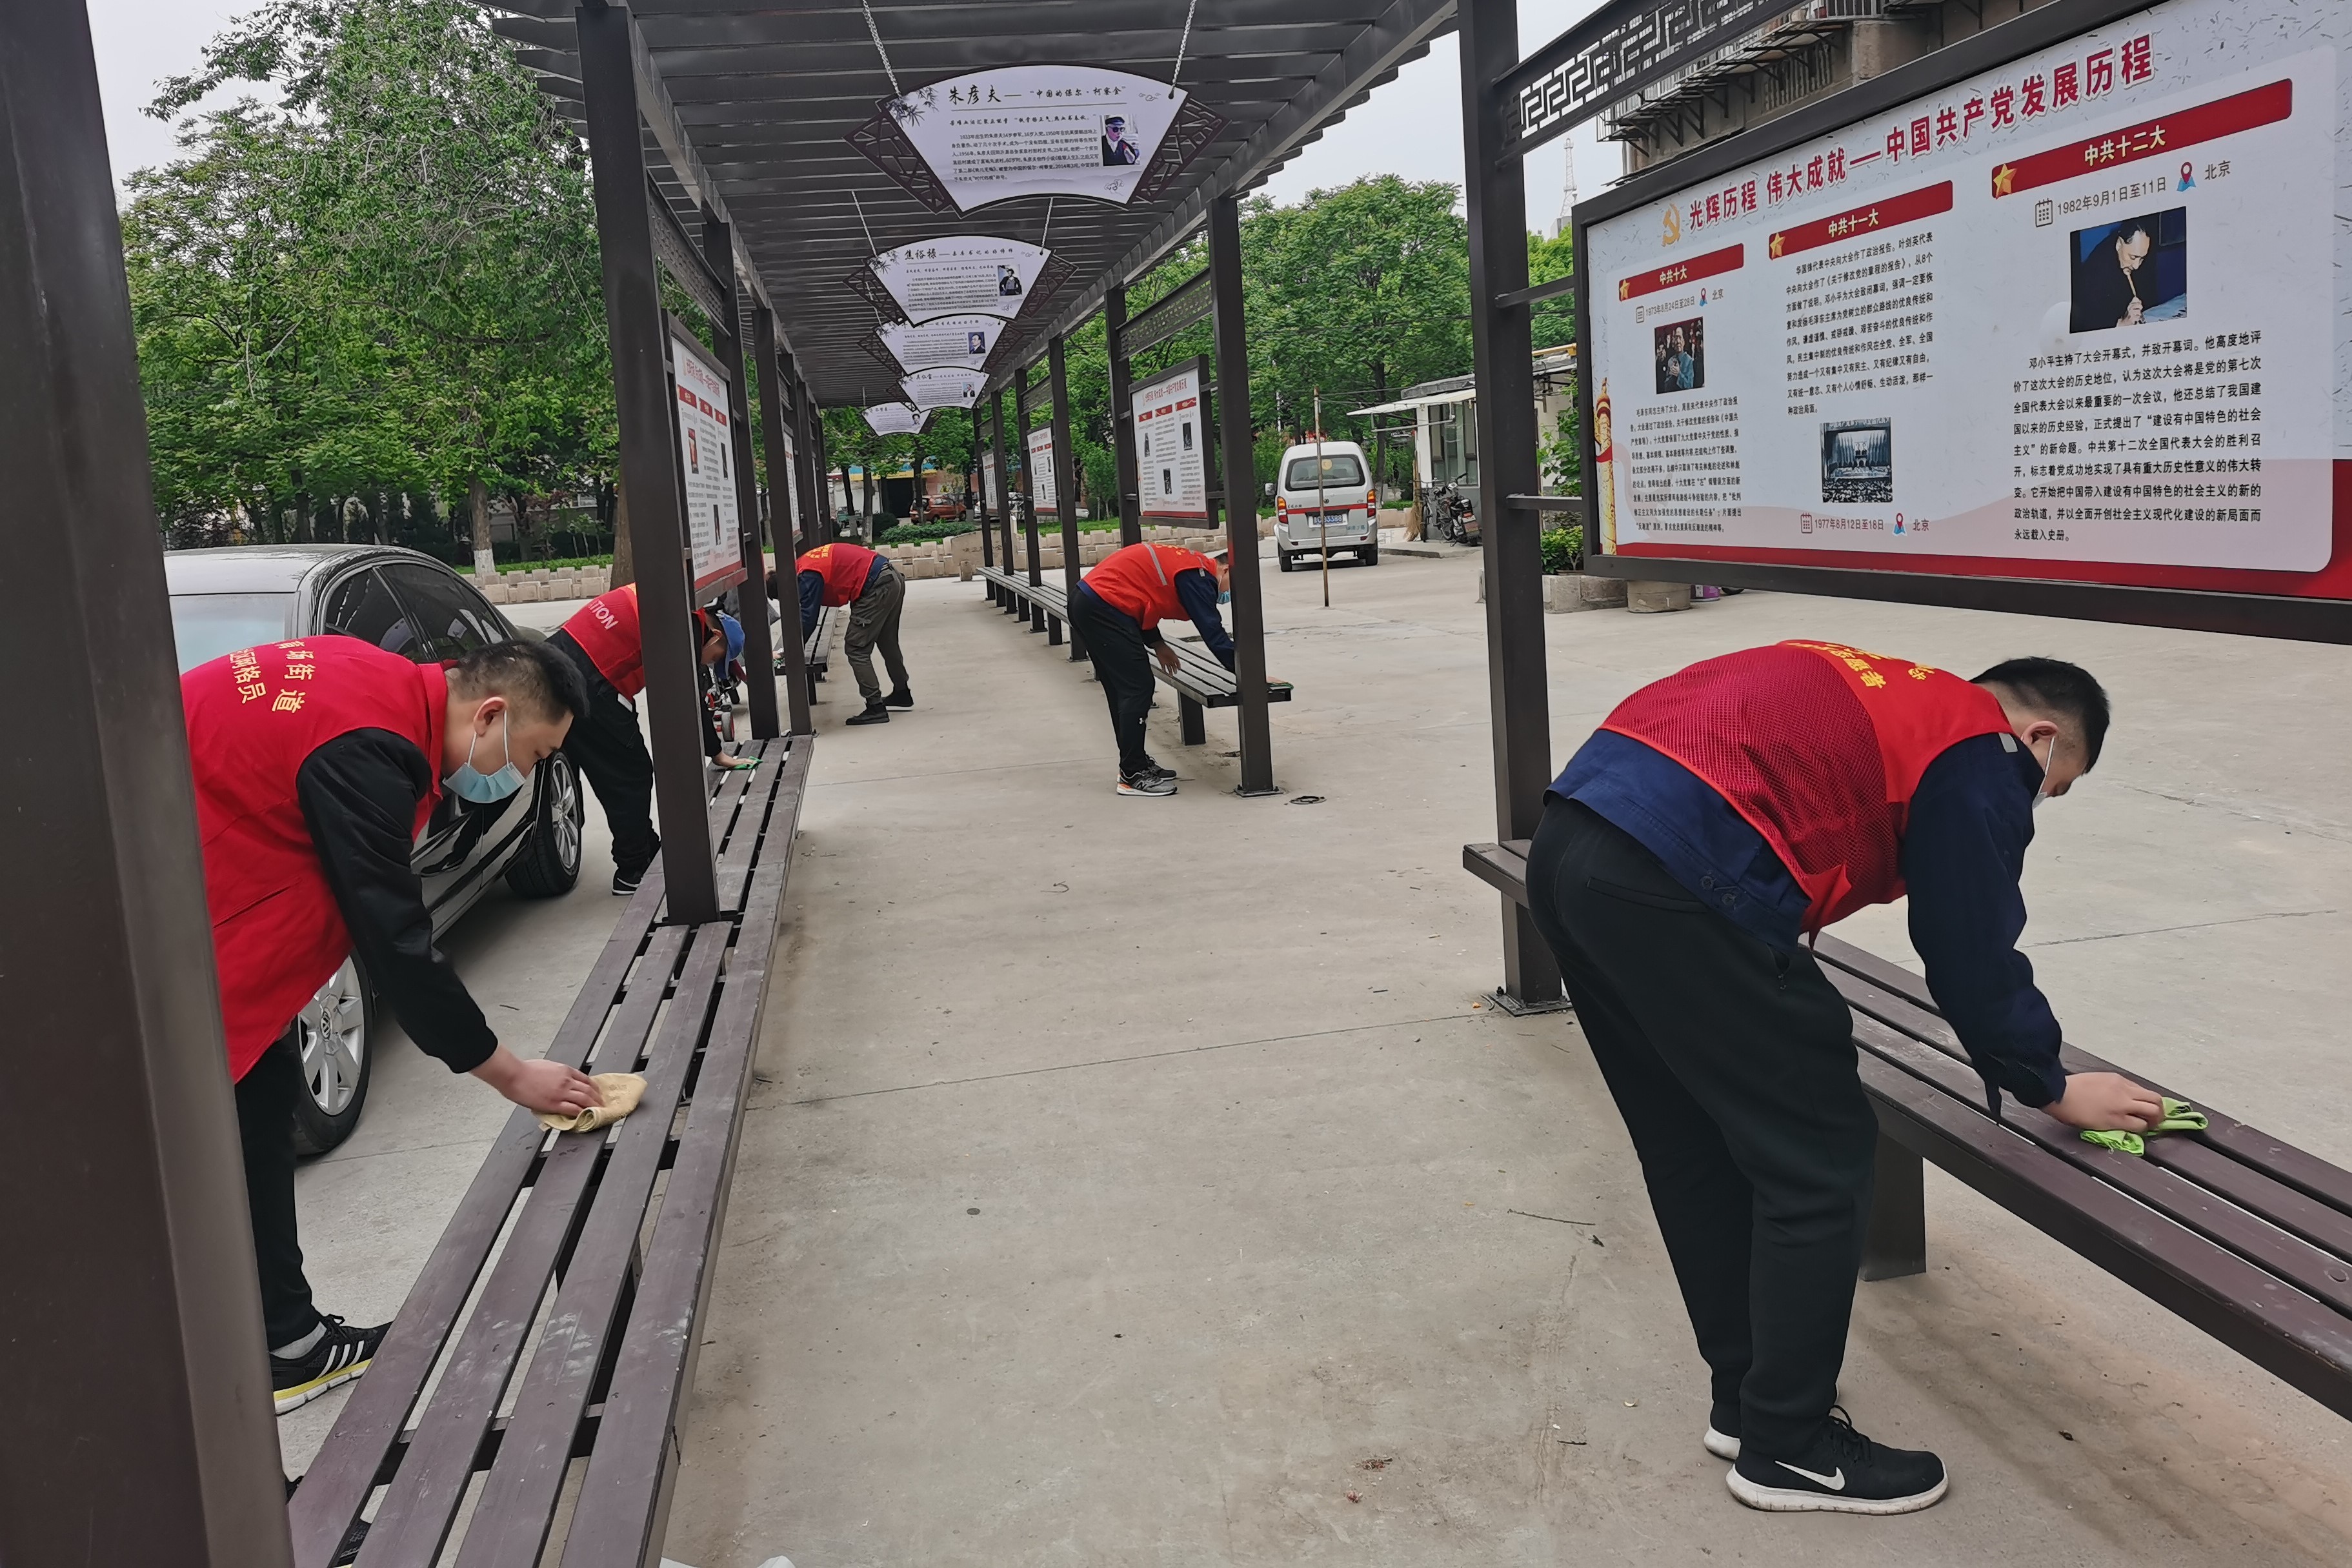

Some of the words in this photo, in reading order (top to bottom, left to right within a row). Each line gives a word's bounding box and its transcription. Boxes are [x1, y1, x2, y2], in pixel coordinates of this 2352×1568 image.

[2084, 124, 2167, 167] 中共十二大
[2056, 176, 2167, 216] 1982年9月1日至11日
[2204, 159, 2231, 181] 北京
[1689, 188, 1758, 233] 光辉历程
[1827, 208, 1880, 239] 中共十一大
[1659, 265, 1687, 286] 中共十大
[1712, 288, 1724, 301] 北京
[1814, 518, 1884, 530] 1977年8月12日至18日
[1913, 518, 1930, 531] 北京
